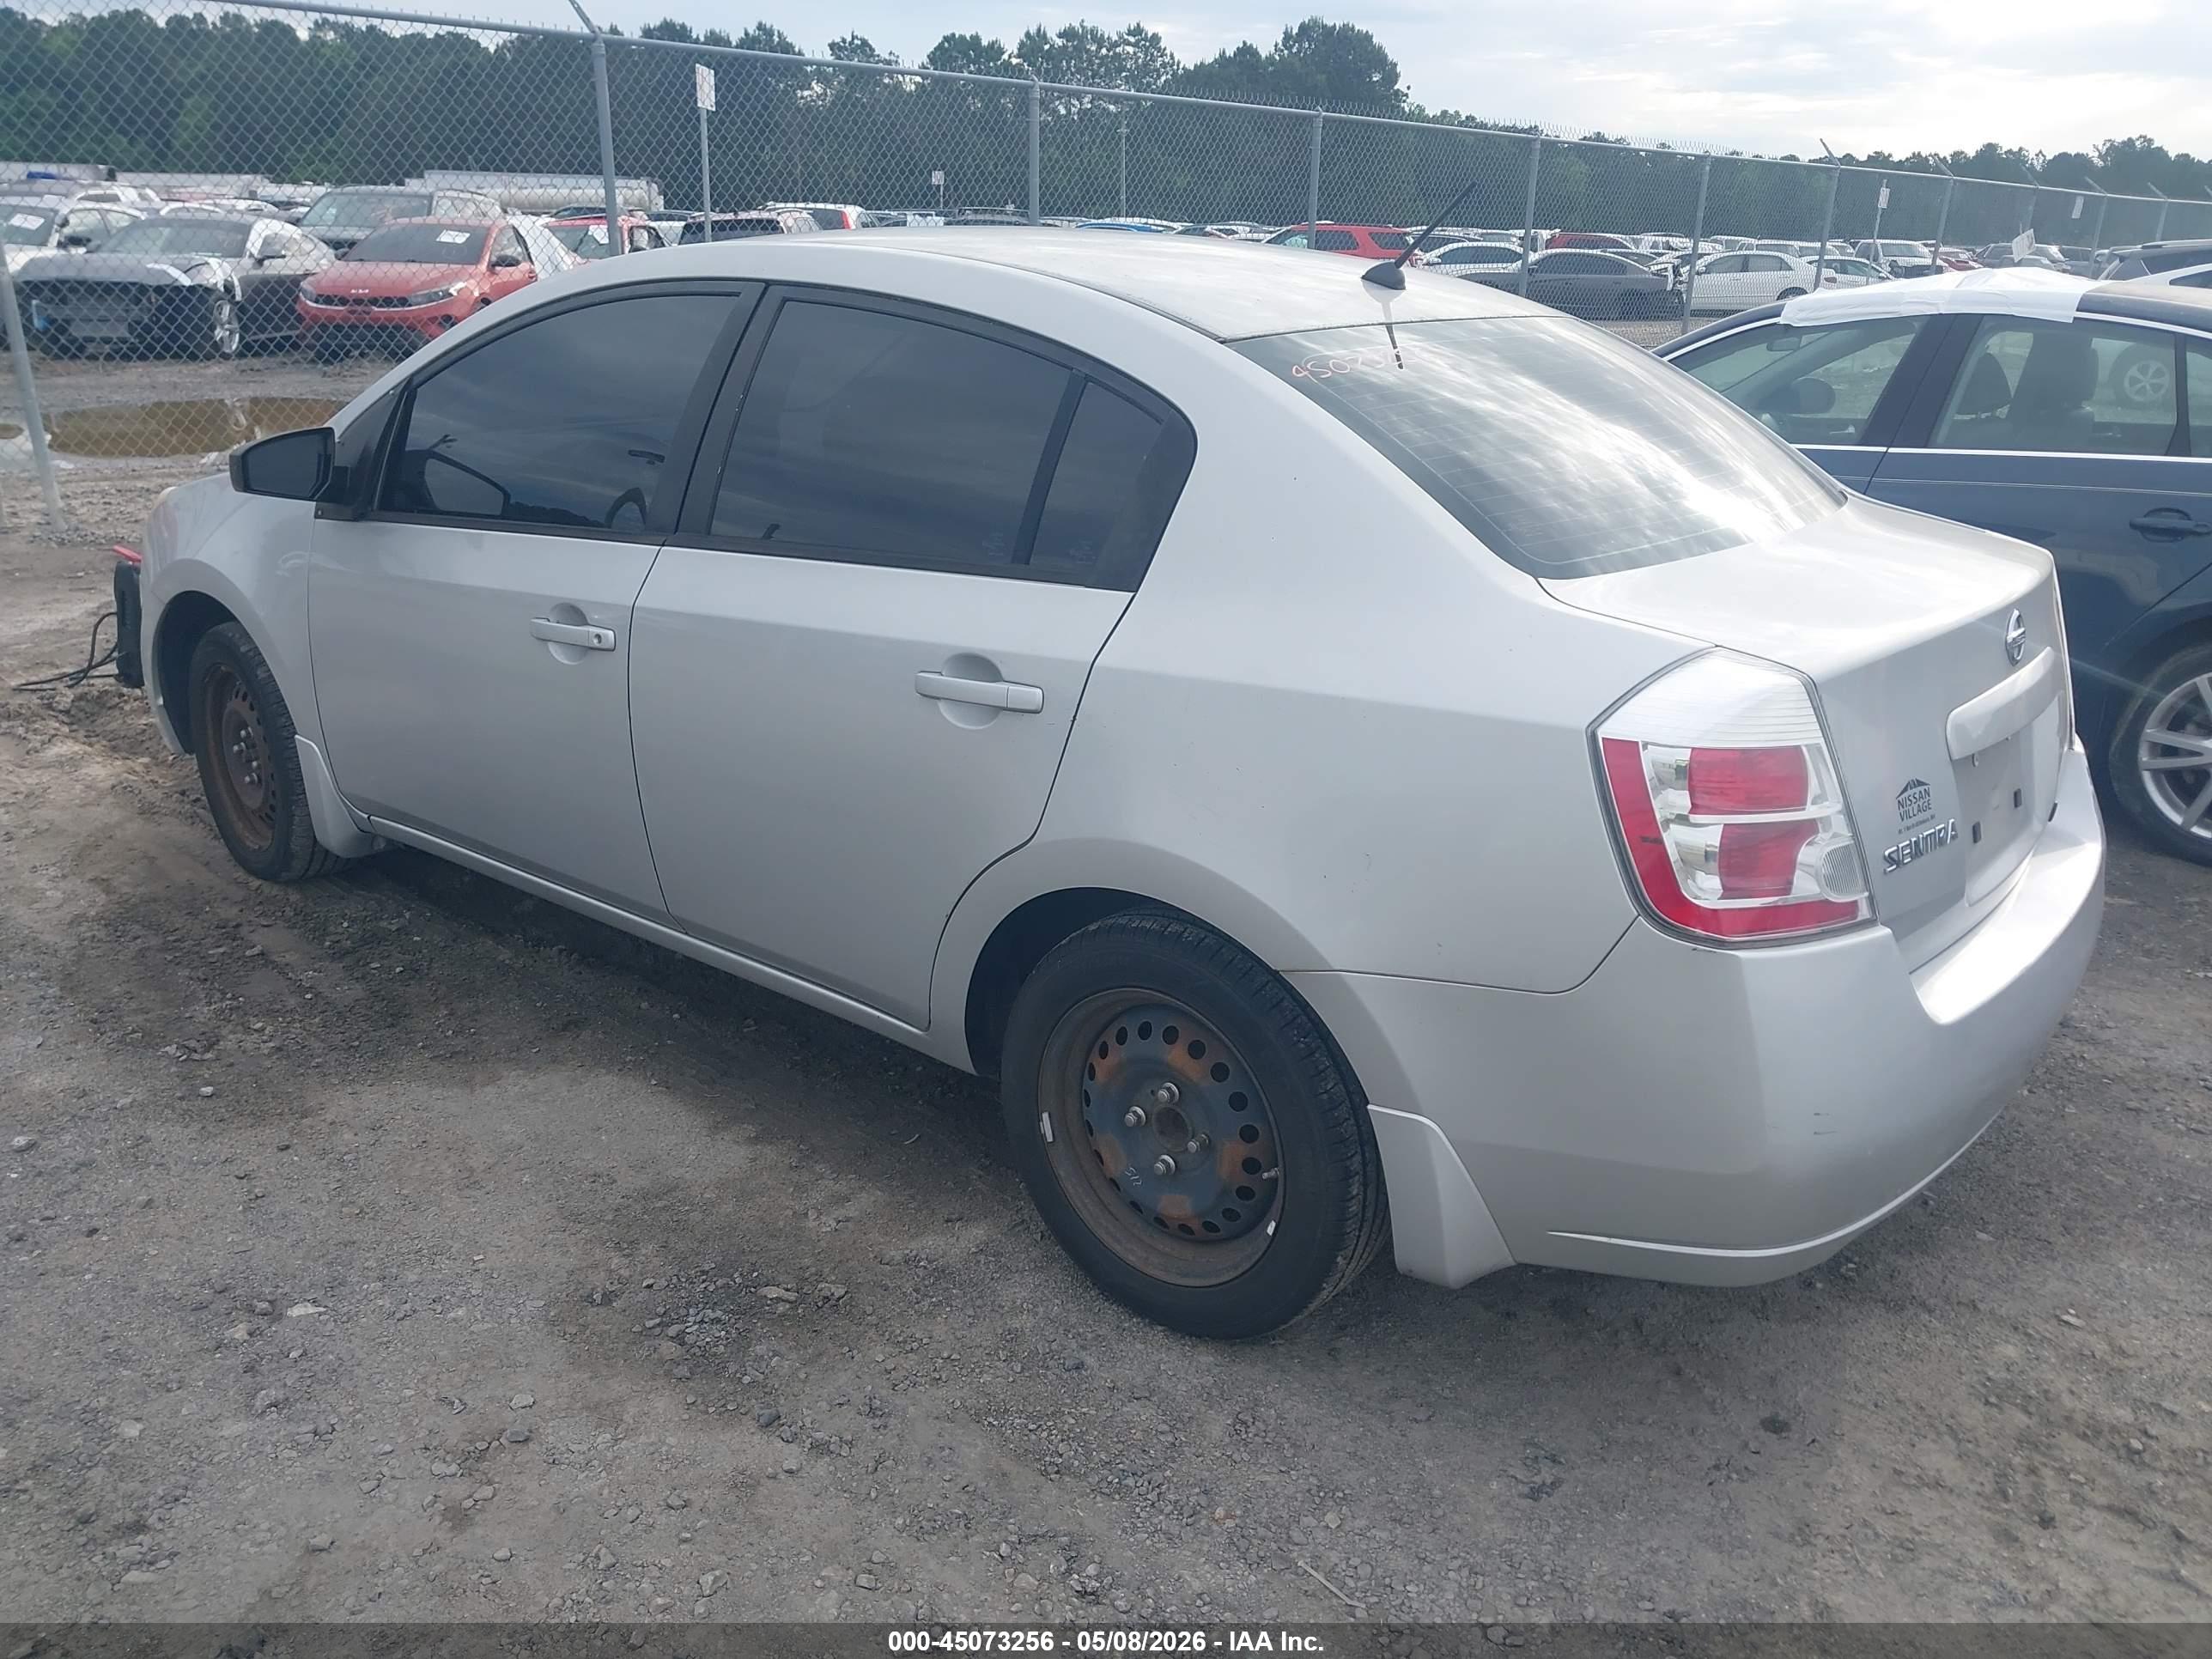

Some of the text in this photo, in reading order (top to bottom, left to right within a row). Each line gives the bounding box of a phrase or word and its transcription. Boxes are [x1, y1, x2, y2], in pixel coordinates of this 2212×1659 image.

[1897, 787, 1931, 811] NISSAN
[1899, 799, 1932, 822] VILLAGE
[1883, 818, 1958, 874] SENTRA
